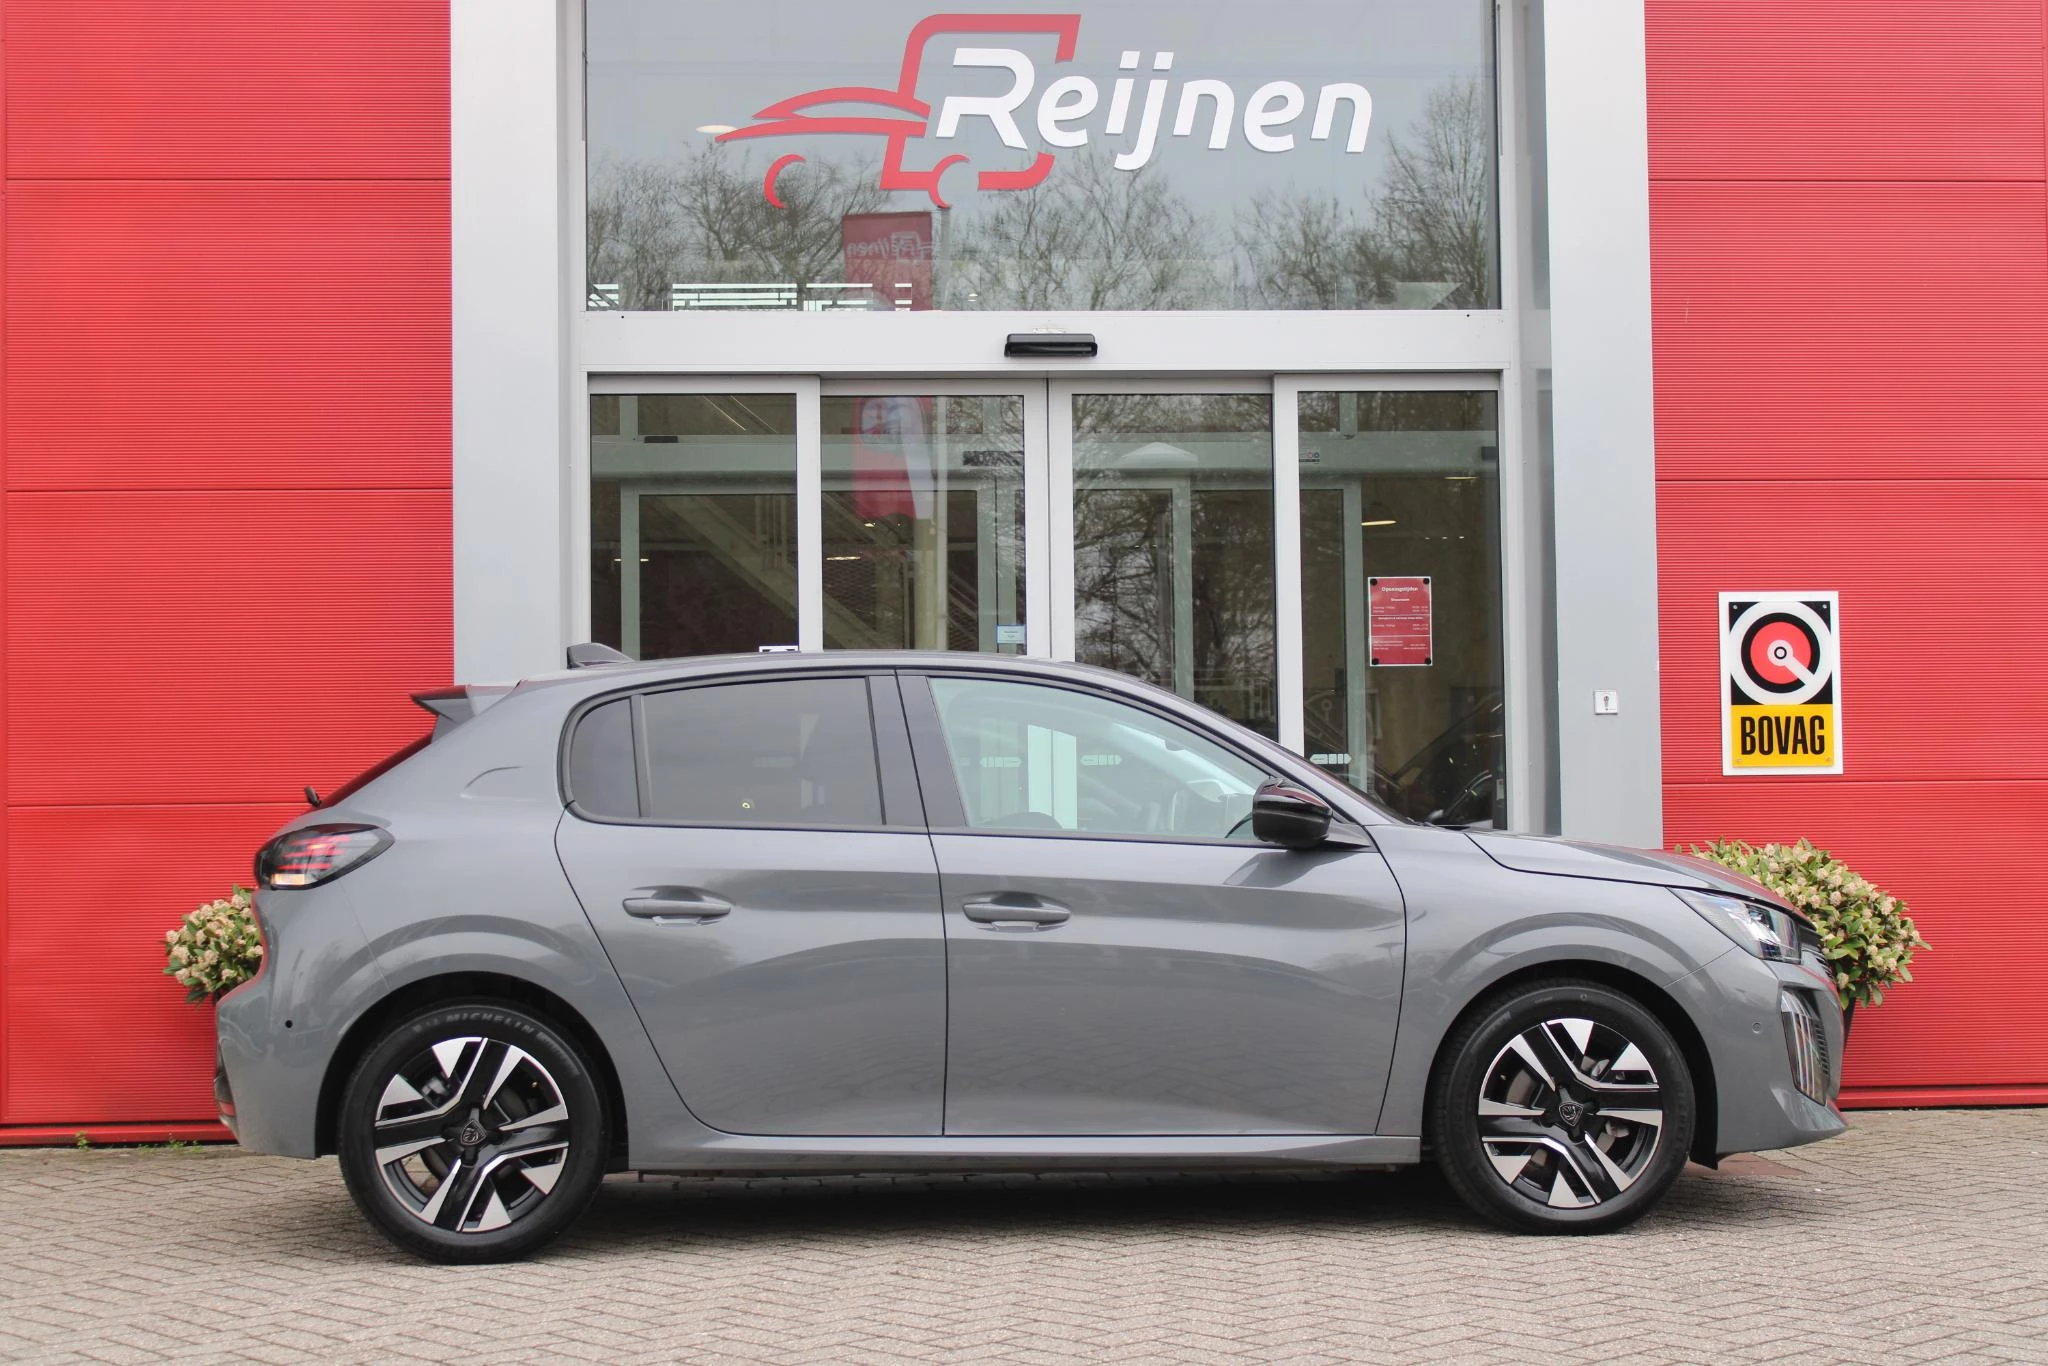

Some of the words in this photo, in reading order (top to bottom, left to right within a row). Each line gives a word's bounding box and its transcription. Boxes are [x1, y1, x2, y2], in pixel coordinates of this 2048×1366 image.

[936, 47, 1373, 171] Reijnen
[1740, 715, 1825, 756] BOVAG
[446, 1011, 535, 1035] MICHELIN
